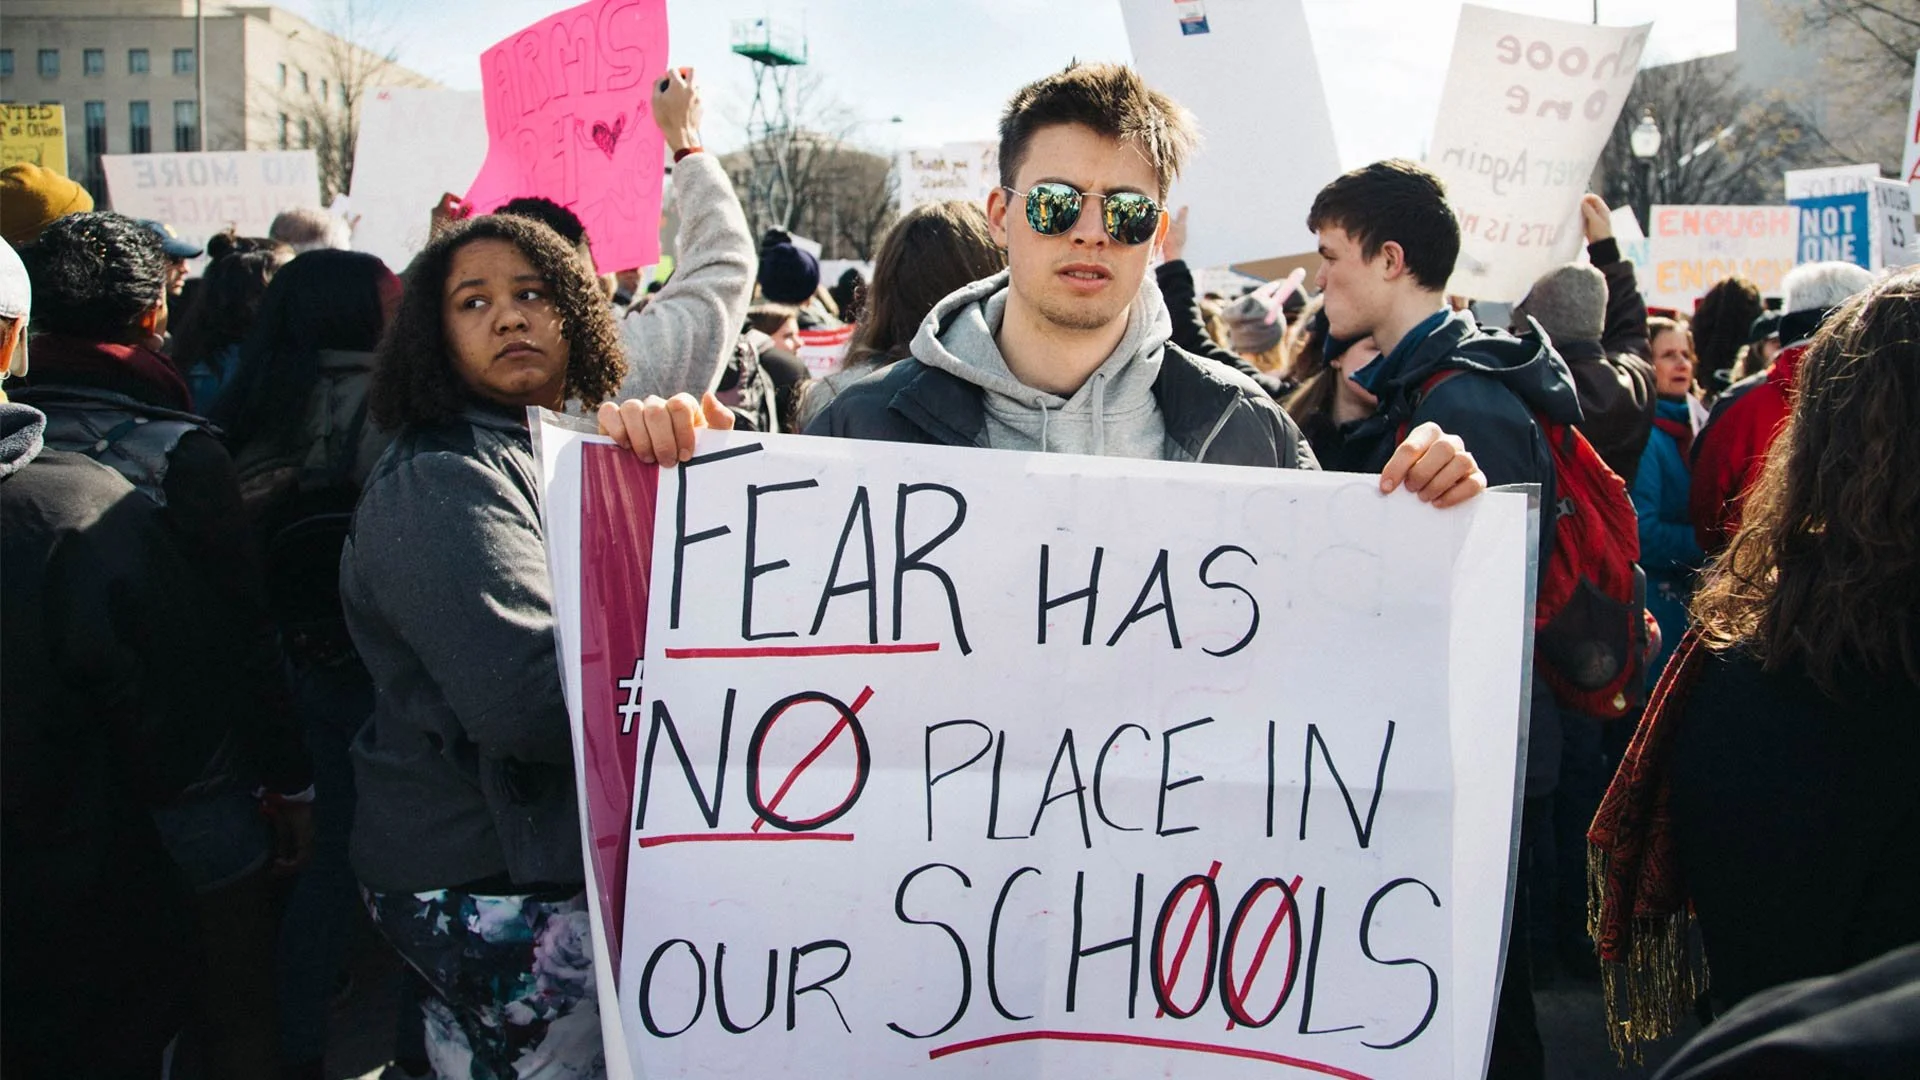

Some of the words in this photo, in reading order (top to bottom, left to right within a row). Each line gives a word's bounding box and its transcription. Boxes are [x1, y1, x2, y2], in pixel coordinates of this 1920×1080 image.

[491, 0, 646, 142] ARMS
[1657, 209, 1791, 238] ENOUGH
[1801, 204, 1858, 238] NOT
[1801, 235, 1858, 263] ONE
[669, 442, 972, 657] FEAR
[1037, 544, 1260, 658] HAS
[635, 685, 875, 832] NO
[925, 717, 1215, 849] PLACE
[1266, 719, 1396, 849] IN
[638, 938, 852, 1039] OUR
[886, 860, 1442, 1050] SCHOOLS
